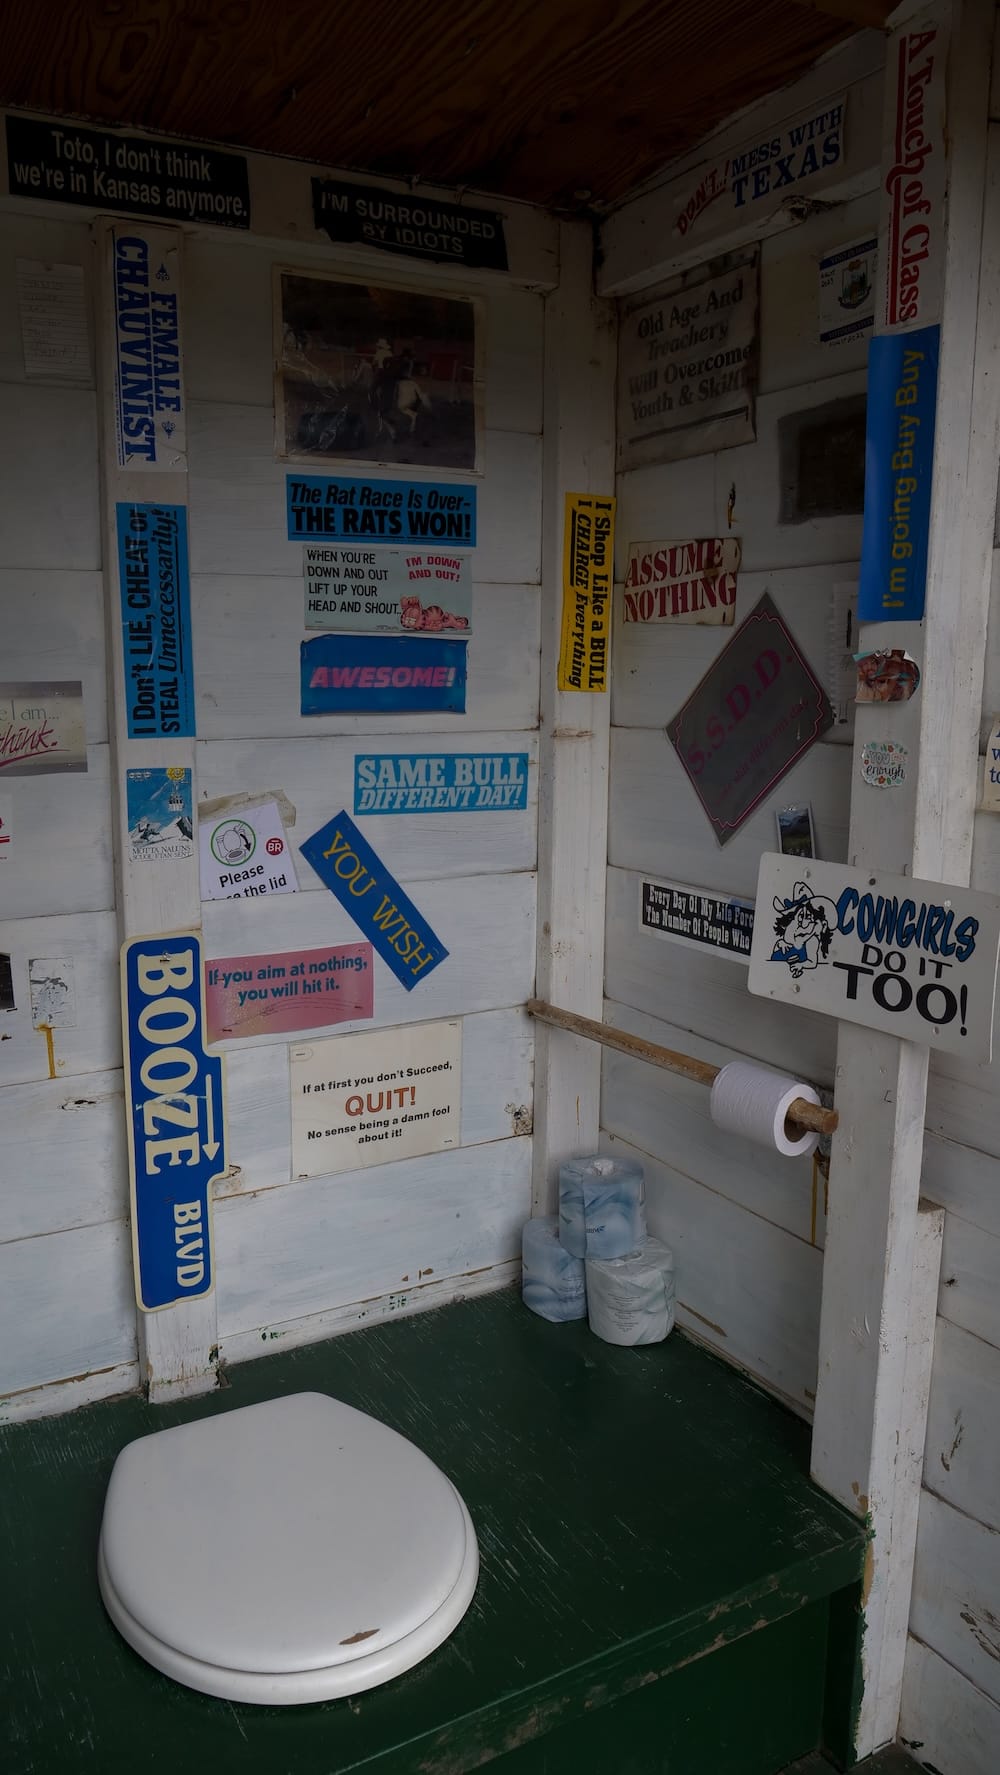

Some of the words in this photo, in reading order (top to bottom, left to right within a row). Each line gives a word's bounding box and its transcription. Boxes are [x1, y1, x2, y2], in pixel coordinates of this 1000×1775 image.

[908, 30, 937, 62] A
[732, 138, 781, 177] MESS
[788, 104, 843, 148] WITH
[886, 56, 934, 195] Touch
[51, 130, 99, 169] Toto,
[104, 139, 110, 166] I
[115, 143, 162, 174] don't
[166, 151, 211, 182] think
[732, 132, 840, 208] TEXAS
[14, 162, 65, 190] we're
[69, 165, 87, 194] in
[93, 171, 161, 205] Kansas
[165, 186, 248, 217] anymore.
[903, 180, 931, 218] of
[320, 191, 349, 213] I'M
[355, 199, 496, 239] SURROUNDED
[362, 221, 388, 239] BY
[395, 227, 464, 252] IDIOTS
[899, 224, 930, 322] Class
[638, 311, 664, 338] Old
[669, 304, 699, 329] Age
[705, 282, 744, 312] And
[116, 236, 156, 462] CHAUVINIST
[151, 291, 181, 412] FEMALE
[648, 320, 729, 360] Treachery
[629, 370, 658, 396] Will
[664, 342, 754, 385] Overcome
[895, 350, 925, 407] Buy
[632, 391, 673, 421] Youth
[679, 385, 694, 406] &
[891, 414, 921, 471] Buy
[290, 483, 322, 504] The
[326, 485, 356, 506] Rat
[359, 486, 404, 508] Race
[408, 489, 423, 509] Is
[596, 502, 612, 511] I
[292, 505, 336, 533] THE
[343, 508, 402, 535] RATS
[408, 511, 471, 538] WON!
[889, 477, 918, 557] going
[307, 549, 338, 563] WHEN
[341, 551, 376, 565] YOU'RE
[576, 513, 591, 591] CHARGE
[590, 516, 610, 567] Shop
[125, 535, 151, 609] CHEAT
[307, 566, 340, 579] DOWN
[344, 568, 365, 580] AND
[368, 569, 389, 581] OUT
[405, 556, 422, 567] I'M
[427, 556, 461, 570] DOWN
[408, 569, 431, 580] AND
[435, 569, 460, 583] OUT!
[625, 538, 724, 588] ASSUME
[151, 508, 179, 673] Unnecessarily!
[309, 583, 330, 595] LIFT
[334, 584, 348, 596] UP
[351, 584, 378, 597] YOUR
[309, 599, 337, 612] HEAD
[340, 601, 361, 613] AND
[592, 574, 608, 615] Like
[624, 572, 736, 622] NOTHING
[882, 568, 907, 607] I'm
[128, 614, 157, 655] LIE,
[568, 592, 585, 688] Everything
[591, 621, 603, 632] a
[309, 666, 457, 689] AWESOME!
[589, 637, 606, 689] BULL
[131, 663, 157, 721] Don't
[160, 677, 181, 733] STEAL
[133, 726, 157, 734] I
[358, 758, 446, 788] SAME
[454, 757, 524, 786] BULL
[866, 764, 905, 780] enough
[357, 786, 476, 811] DIFFERENT
[476, 785, 522, 808] DAY!
[219, 865, 265, 888] Please
[244, 882, 267, 898] the
[269, 874, 287, 890] lid
[322, 830, 377, 896] YOU
[372, 895, 434, 976] WISH
[649, 886, 670, 909] Every
[673, 891, 686, 914] Day
[689, 896, 698, 914] Of
[701, 898, 713, 921] My
[716, 902, 732, 922] Life
[647, 905, 660, 924] The
[662, 909, 691, 933] Number
[692, 917, 701, 936] Of
[703, 920, 730, 945] People
[732, 928, 750, 950] Who
[836, 886, 979, 963] COWGIRLS
[208, 968, 220, 986] If
[222, 971, 252, 988] you
[257, 965, 286, 980] aim
[290, 963, 305, 977] at
[309, 956, 368, 974] nothing,
[861, 944, 907, 972] DO
[920, 957, 953, 978] IT
[238, 986, 268, 1006] you
[271, 981, 298, 997] will
[302, 979, 322, 994] hit
[325, 977, 340, 991] it.
[833, 962, 968, 1036] TOO!
[136, 948, 200, 1176] BOOZE
[303, 1084, 312, 1094] If
[314, 1083, 325, 1092] at
[328, 1079, 351, 1090] first
[354, 1076, 374, 1087] you
[377, 1070, 404, 1082] don't
[406, 1061, 452, 1077] Succeed,
[345, 1086, 416, 1117] QUIT!
[307, 1131, 322, 1140] No
[325, 1124, 356, 1136] sense
[359, 1117, 389, 1130] being
[401, 1111, 430, 1123] damn
[432, 1105, 450, 1116] fool
[358, 1131, 389, 1144] about
[391, 1129, 402, 1138] it!
[173, 1199, 205, 1288] BLVD
